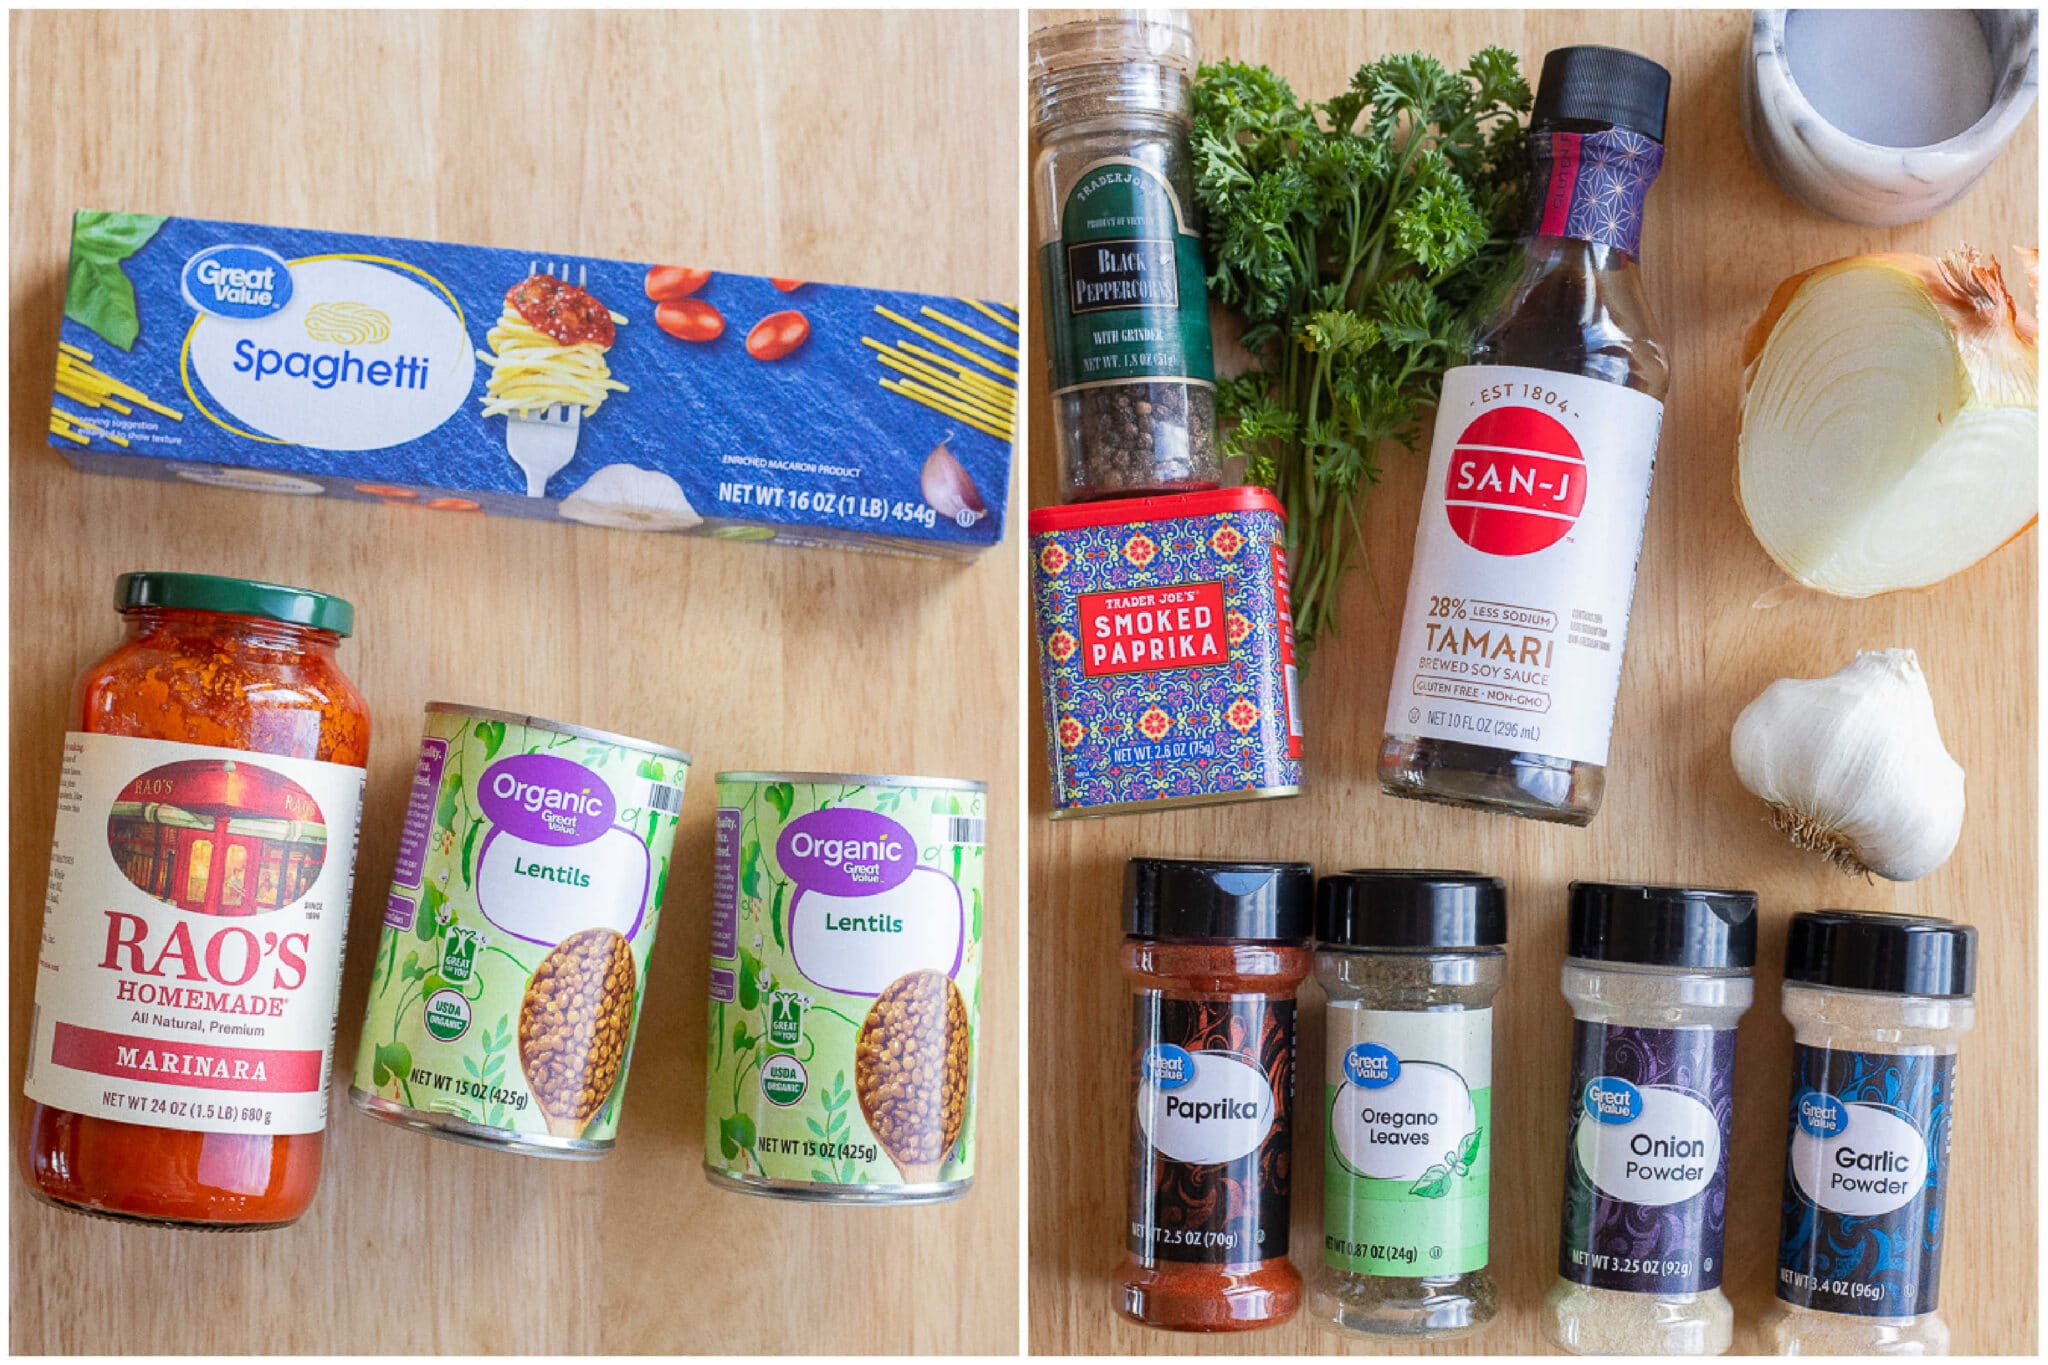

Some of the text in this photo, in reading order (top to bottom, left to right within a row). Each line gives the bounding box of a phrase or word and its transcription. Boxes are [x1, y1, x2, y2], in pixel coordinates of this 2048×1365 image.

[1078, 173, 1123, 201] TRADER
[1098, 249, 1146, 273] BLACK
[197, 259, 275, 289] Great
[214, 280, 273, 306] Value
[1093, 331, 1119, 345] WITH
[233, 339, 430, 391] Spaghetti
[1481, 384, 1570, 413] EST 1804
[112, 419, 159, 431] suggestion
[128, 431, 150, 440] show
[152, 434, 182, 444] texture
[722, 454, 861, 478] ENRICHED MACARONI PRODUCT
[1457, 461, 1570, 501] SAN-J
[719, 482, 936, 528] NET WT 16 OZ (1 LB) 454g
[1105, 590, 1196, 610] TRADER JOE'S
[1428, 595, 1466, 620] 28%
[1473, 606, 1499, 618] LESS
[1502, 610, 1551, 627] SODIUM
[1094, 606, 1212, 638] SMOKED
[1092, 633, 1218, 667] PAPRIKA
[1426, 622, 1554, 668] TAMARI
[1418, 656, 1550, 686] BREWED SOY SAUCE
[1417, 681, 1543, 707] GLUTEN FREE NON-GMO
[1427, 710, 1447, 727] NET
[1448, 712, 1461, 728] 10
[1462, 714, 1476, 730] FL
[1477, 717, 1493, 733] OZ
[1494, 719, 1519, 737] (296
[1114, 747, 1133, 763] NET
[1154, 744, 1171, 759] 2.6
[1173, 742, 1187, 758] OZ
[1189, 740, 1215, 758] (75g)
[134, 778, 174, 795] RAO'S
[493, 773, 603, 818] Organic
[541, 809, 577, 828] Great
[790, 832, 903, 867] Organic
[514, 857, 591, 888] Lentils
[843, 862, 880, 876] Great
[852, 873, 880, 884] Value
[825, 913, 904, 934] Lentils
[97, 910, 311, 991] RAO'S
[445, 956, 470, 969] GREAT
[116, 979, 285, 1017] HOMEMADE
[435, 1000, 462, 1016] USDA
[131, 1010, 265, 1037] All Natural, Premium
[429, 1015, 463, 1030] ORGANIC
[773, 1021, 798, 1031] GREAT
[782, 1031, 798, 1041] YOU
[116, 1046, 268, 1081] MARINARA
[1349, 1051, 1389, 1071] Great
[770, 1067, 797, 1080] USDA
[1356, 1067, 1389, 1081] Value
[409, 1067, 529, 1111] NET WT 15 OZ (425g)
[767, 1081, 801, 1093] ORGANIC
[1589, 1086, 1631, 1107] Great
[102, 1090, 124, 1107] NET
[127, 1094, 148, 1112] WT
[150, 1098, 167, 1114] 24
[170, 1100, 188, 1117] OZ
[189, 1102, 215, 1120] (1.5
[217, 1105, 239, 1122] LB)
[241, 1106, 264, 1121] 680
[1166, 1095, 1258, 1124] Paprika
[1597, 1101, 1631, 1117] Value
[1802, 1101, 1837, 1121] Great
[1361, 1107, 1439, 1131] Oregano
[1808, 1116, 1837, 1131] Value
[758, 1136, 878, 1163] NET WT 15 OZ (425g)
[1370, 1129, 1430, 1146] Leaves
[1630, 1133, 1705, 1158] Onion
[1626, 1161, 1704, 1181] Powder
[1835, 1147, 1910, 1173] Garlic
[1831, 1172, 1909, 1195] Powder
[1164, 1229, 1182, 1245] 2.5
[1185, 1232, 1202, 1245] OZ
[1204, 1232, 1238, 1250] (70g)
[1334, 1240, 1346, 1254] WT
[1346, 1241, 1368, 1258] 0.87
[1370, 1243, 1386, 1259] OZ
[1386, 1245, 1418, 1264] (24g)
[1571, 1248, 1693, 1278] NET WT 3.25 OZ (92g)
[1794, 1271, 1809, 1289] WT
[1810, 1277, 1830, 1293] 3.4
[1832, 1280, 1849, 1296] OZ
[1850, 1282, 1885, 1301] (96g)
